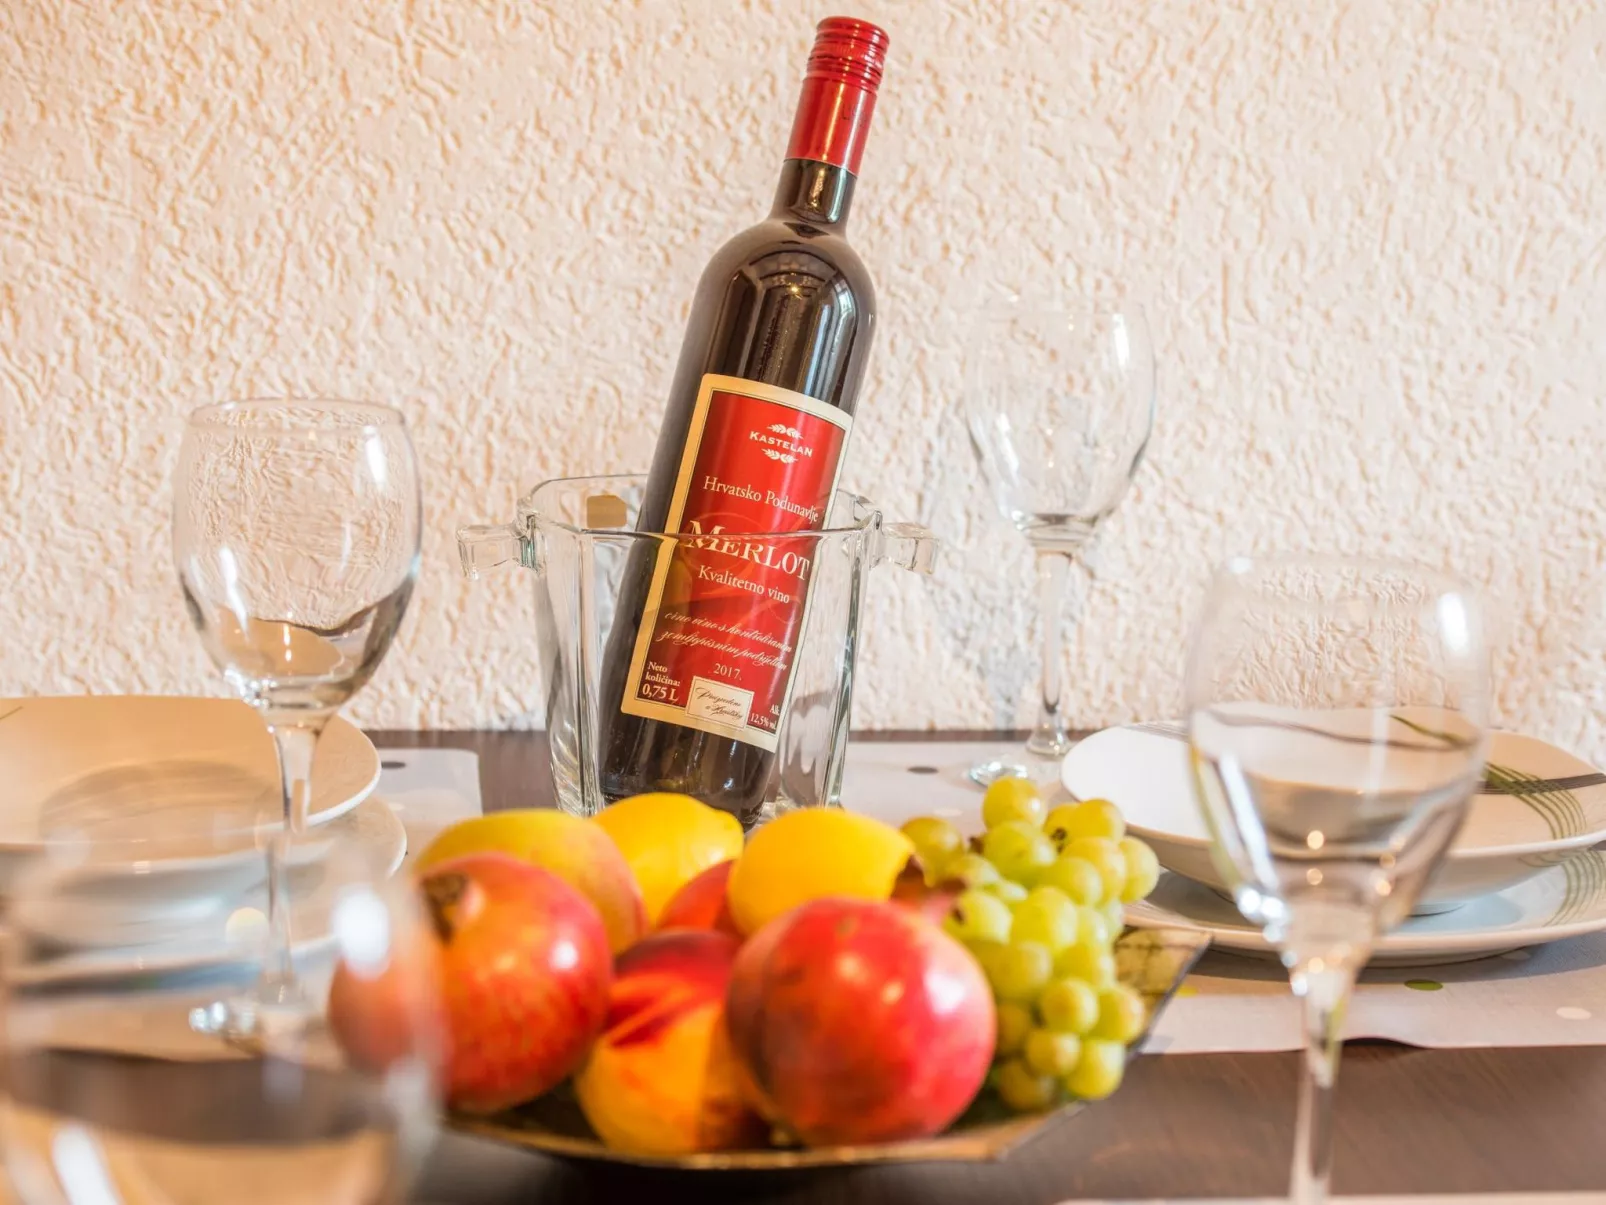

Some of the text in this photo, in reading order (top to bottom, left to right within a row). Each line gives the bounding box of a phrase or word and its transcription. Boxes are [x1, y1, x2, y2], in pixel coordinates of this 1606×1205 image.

[749, 430, 813, 458] KASTELAN
[703, 475, 819, 524] Hrvatsko Podunavlje
[684, 520, 810, 580] MERLOT
[698, 564, 790, 604] Kvalitetno vino
[647, 661, 668, 673] Neto
[713, 662, 742, 682] 2017.
[645, 672, 681, 687] količina:
[642, 683, 679, 702] 0,75 L
